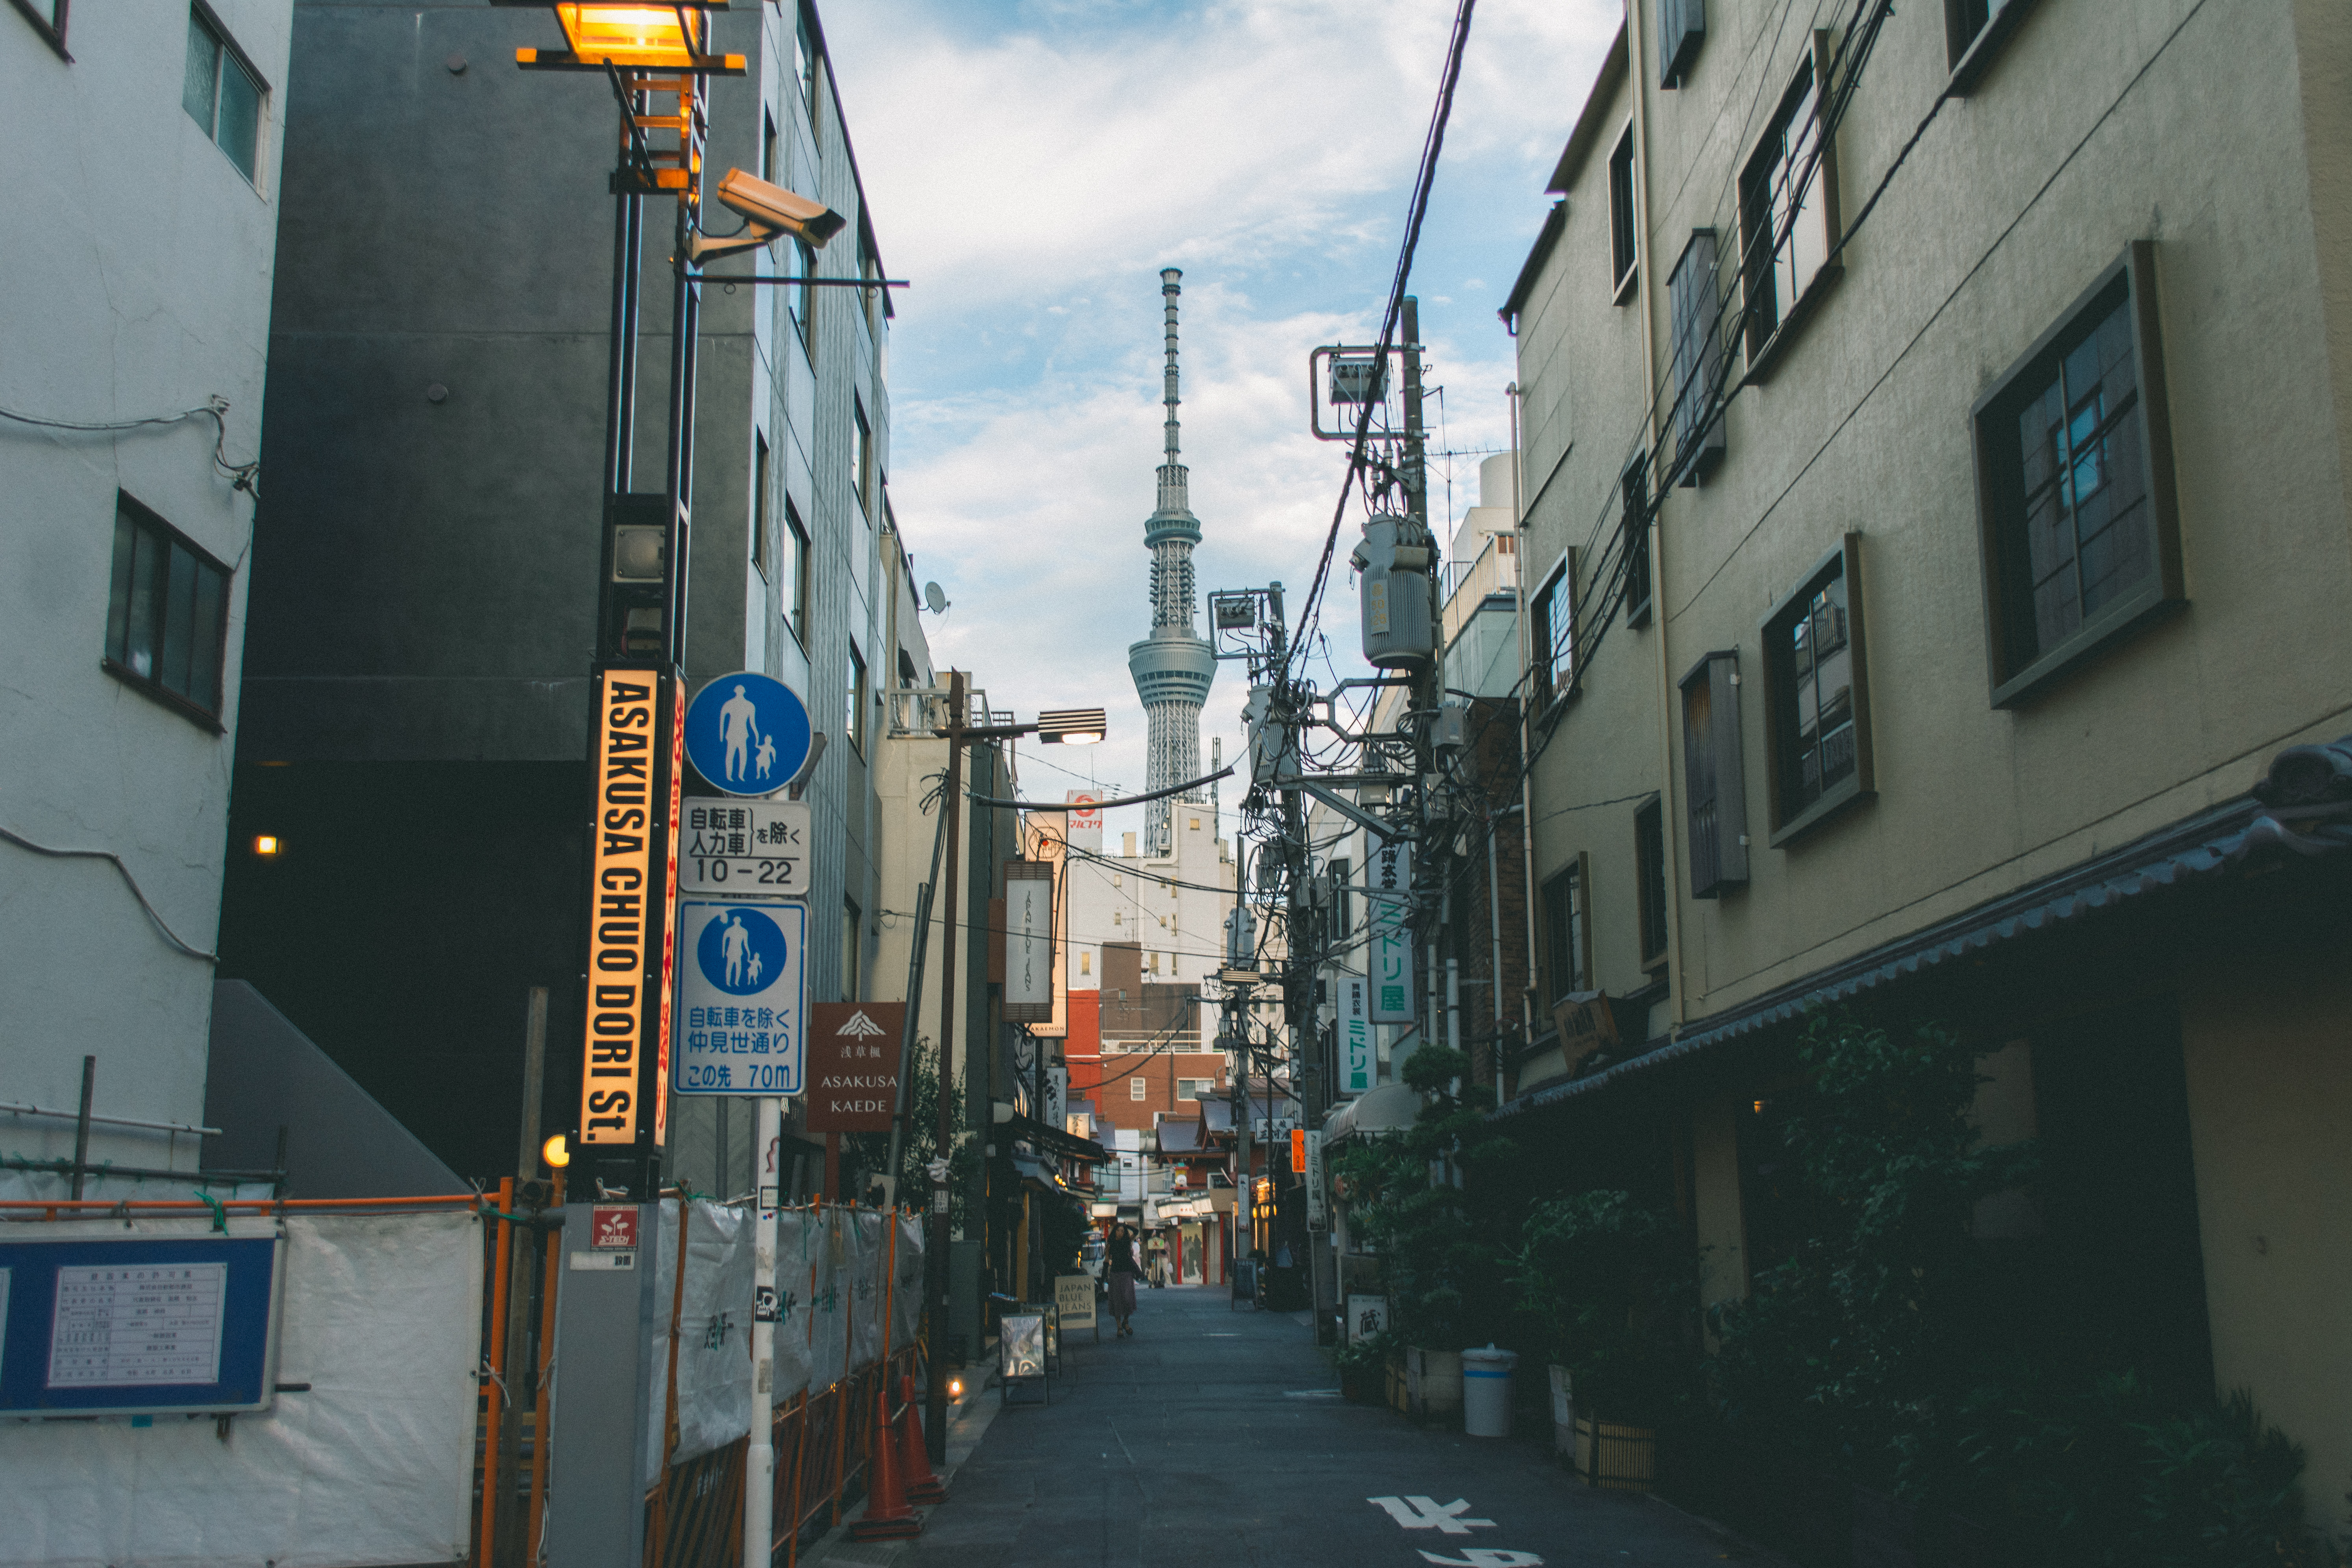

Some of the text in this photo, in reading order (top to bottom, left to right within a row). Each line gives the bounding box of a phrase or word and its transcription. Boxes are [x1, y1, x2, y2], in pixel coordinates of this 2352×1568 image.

[691, 808, 746, 831] 自転車
[690, 832, 746, 855] 人力車
[757, 823, 801, 844] を除く
[697, 859, 727, 883] 10
[759, 861, 792, 884] 22
[587, 681, 650, 1142] ASAKUSA CHUO DORI St.
[689, 1008, 790, 1029] 自転車を除く
[688, 1032, 789, 1054] 仲見世通り
[840, 1046, 881, 1058] 浅草楓
[1349, 1020, 1367, 1089] ミドリ屋
[688, 1064, 790, 1088] この先 70m
[822, 1075, 897, 1088] ASAKUSA
[832, 1100, 886, 1112] KAEDE
[1059, 1293, 1083, 1302] BLUE
[1060, 1283, 1091, 1293] JAPAN
[1059, 1301, 1091, 1311] JEANS
